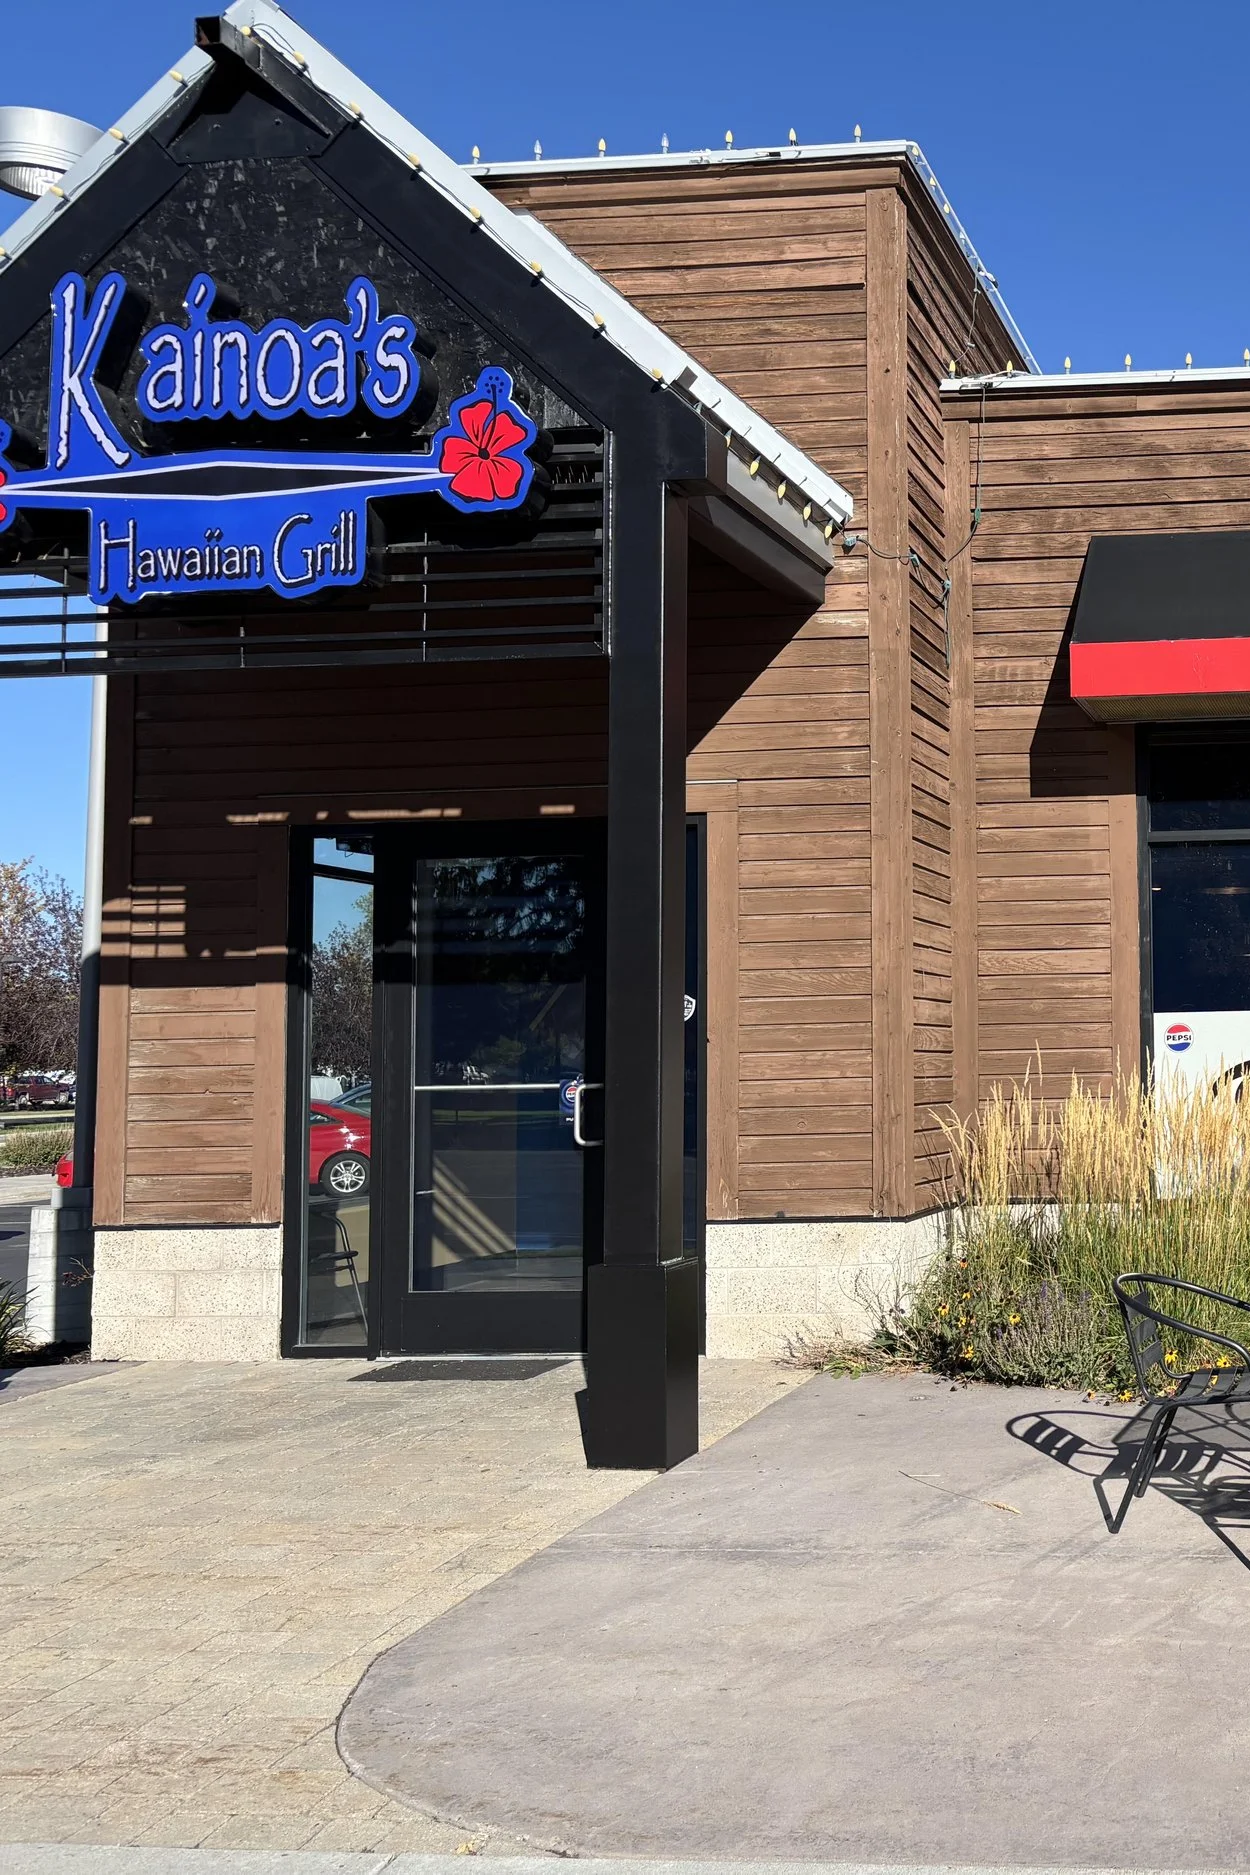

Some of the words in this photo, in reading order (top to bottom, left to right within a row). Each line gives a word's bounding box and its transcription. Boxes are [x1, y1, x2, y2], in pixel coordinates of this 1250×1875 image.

[56, 281, 410, 468] Kainoa's
[98, 518, 264, 592] Hawaiian
[272, 510, 358, 587] Grill
